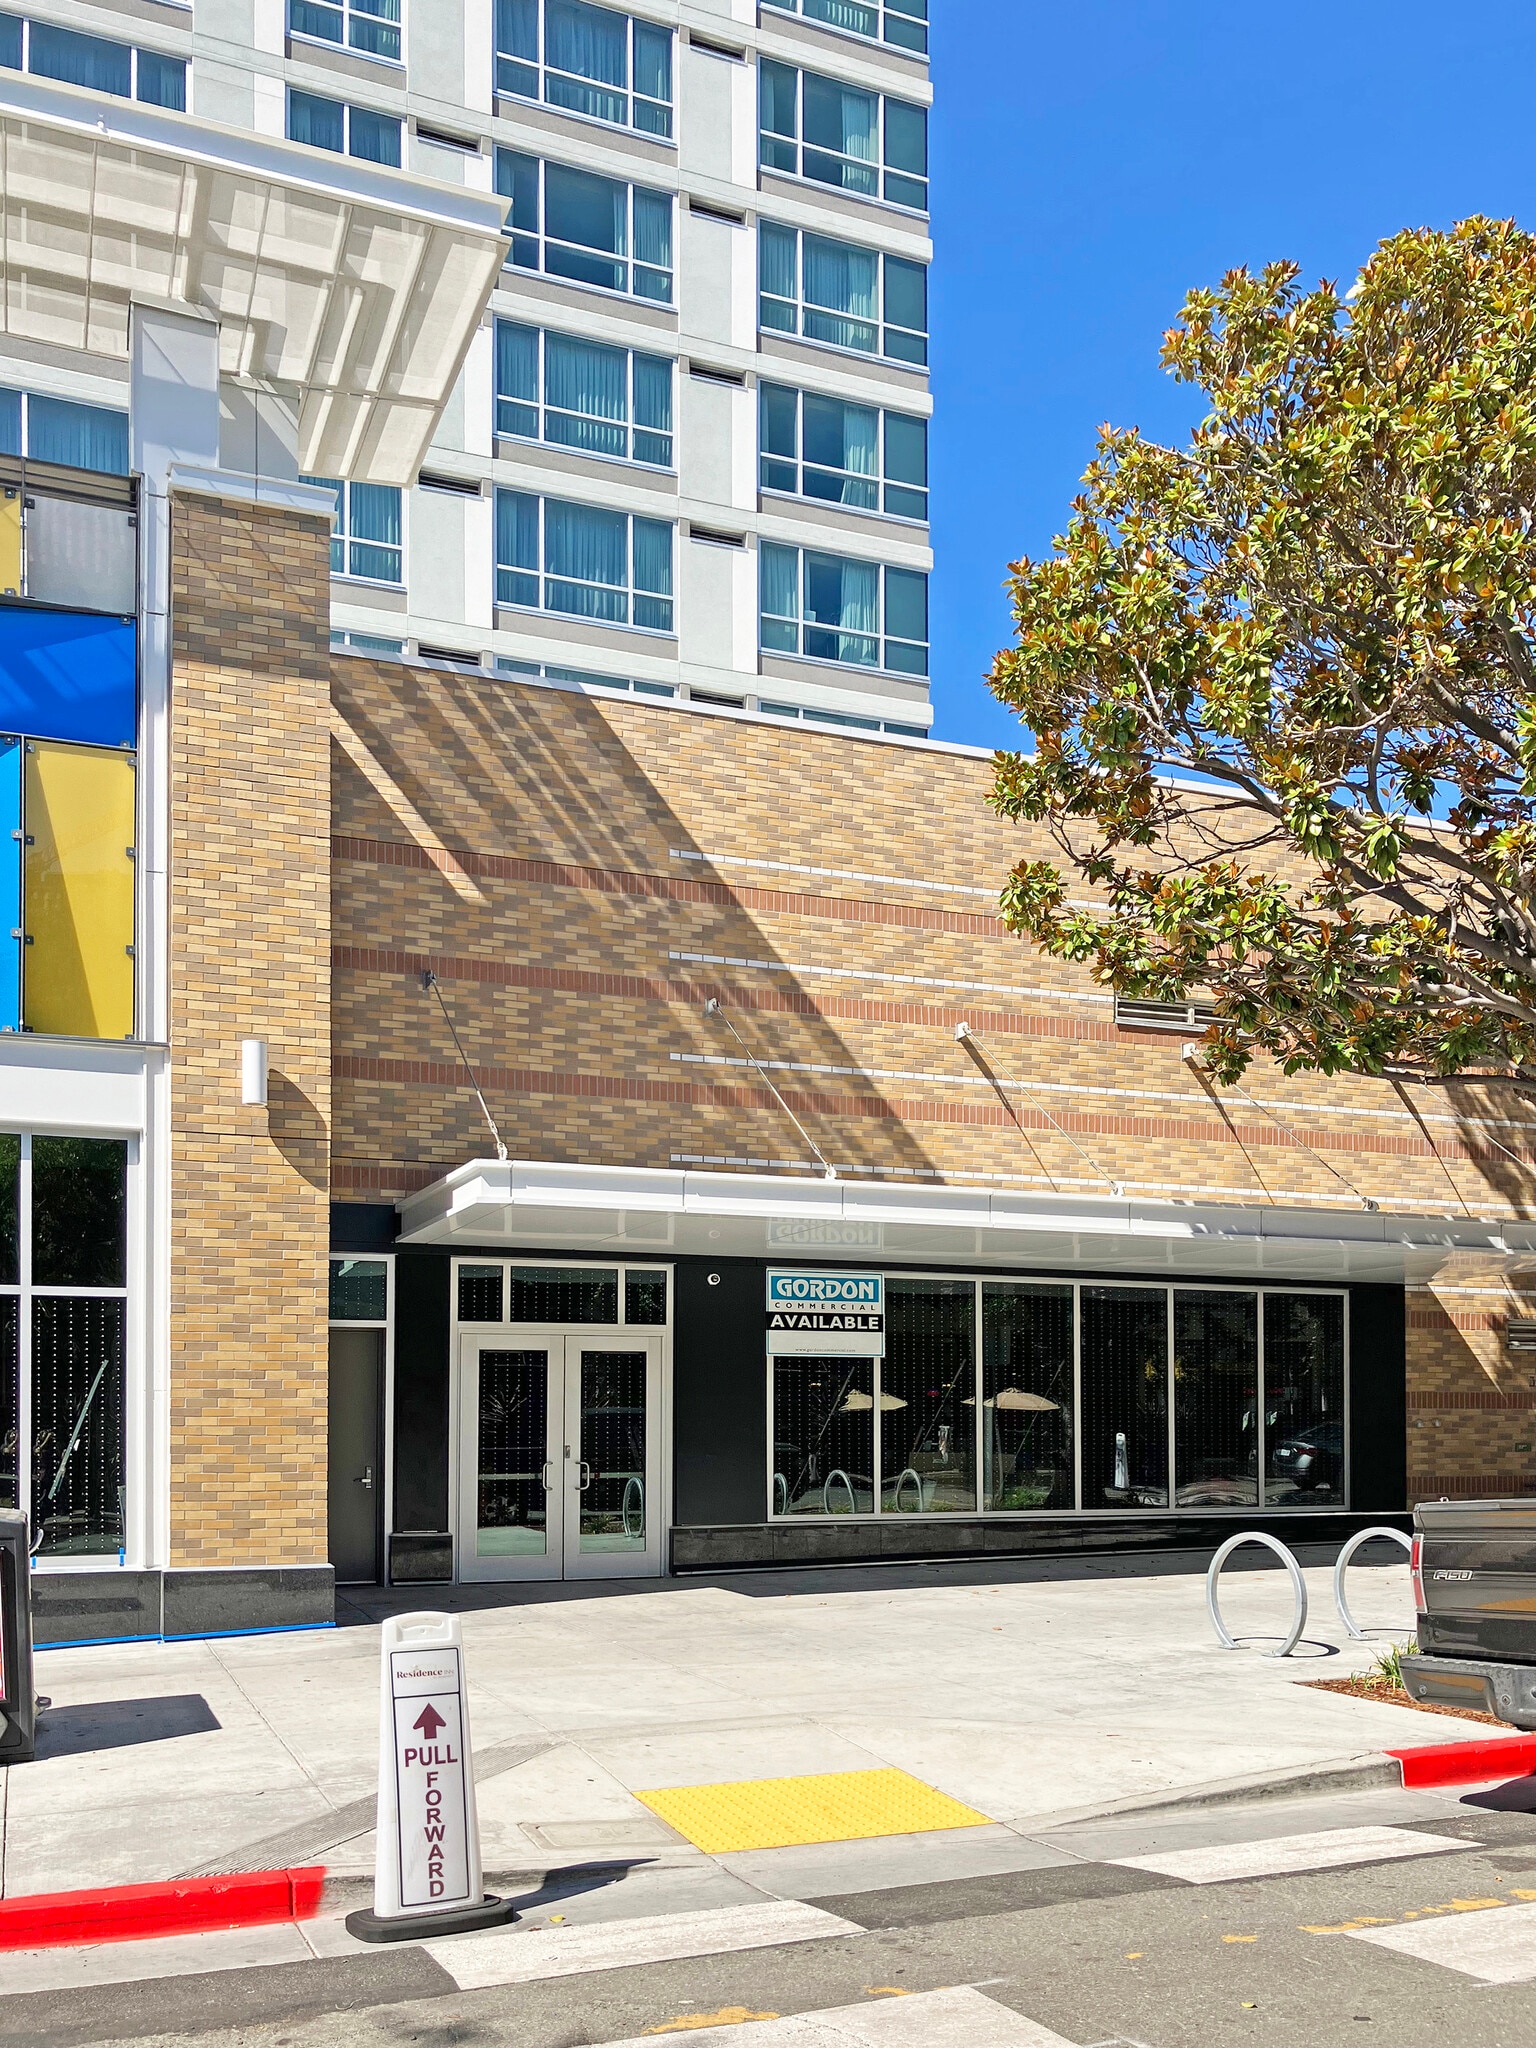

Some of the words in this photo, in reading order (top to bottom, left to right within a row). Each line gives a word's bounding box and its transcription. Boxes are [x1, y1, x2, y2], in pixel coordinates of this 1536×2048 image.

[776, 1278, 874, 1300] GORDON
[775, 1302, 876, 1311] COMMERCIAL
[770, 1314, 879, 1330] AVAILABLE
[396, 1669, 443, 1679] Residence
[404, 1744, 458, 1767] PULL
[424, 1771, 446, 1897] FORWARD
